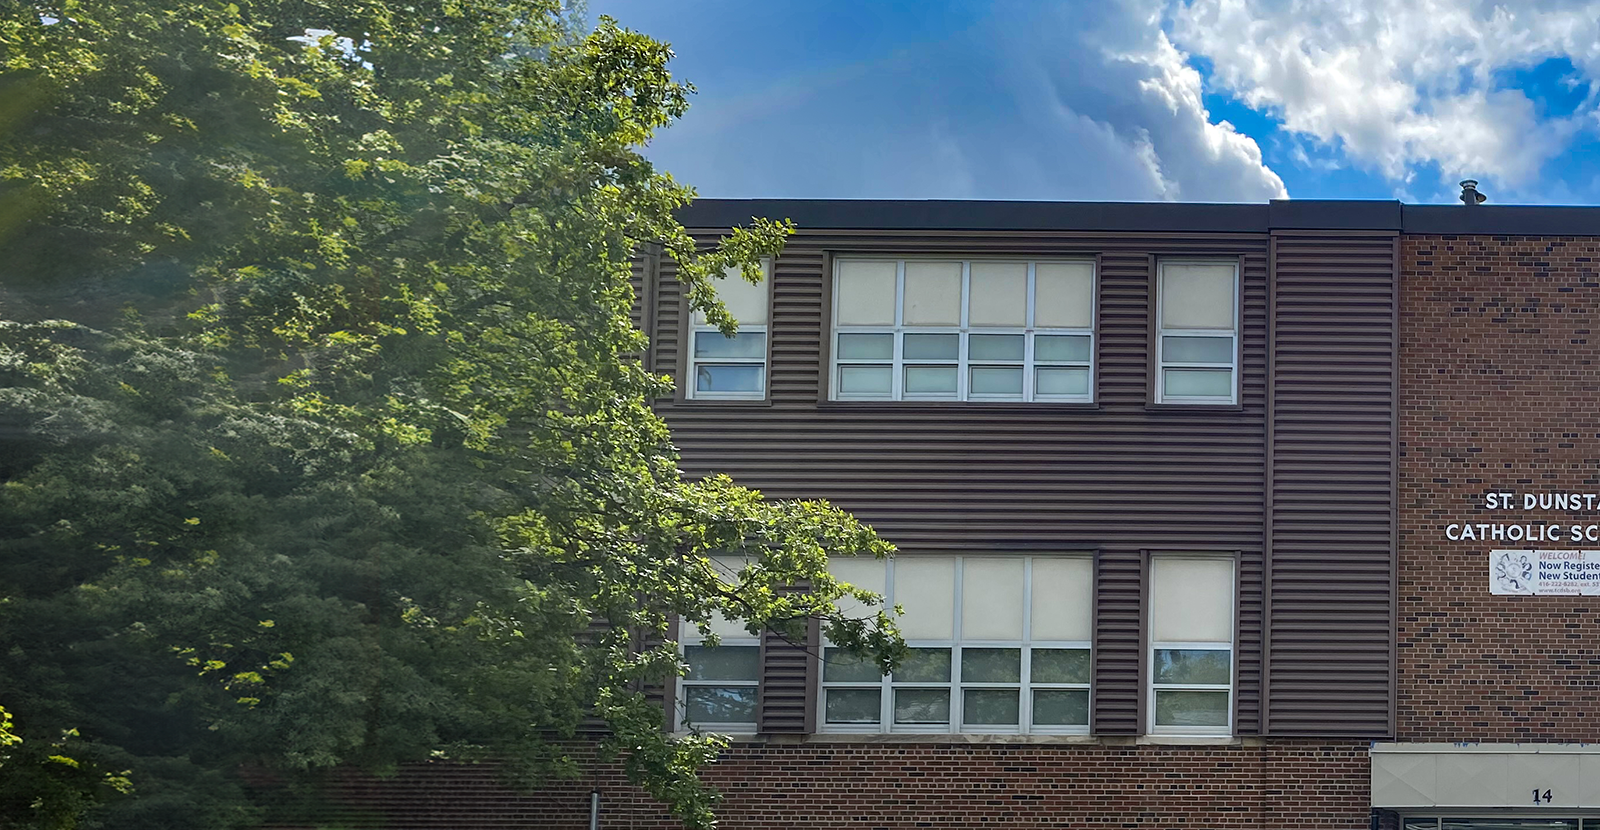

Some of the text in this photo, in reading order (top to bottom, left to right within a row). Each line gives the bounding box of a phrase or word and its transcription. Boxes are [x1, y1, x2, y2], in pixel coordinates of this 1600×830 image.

[1485, 492, 1514, 510] ST.
[1445, 523, 1560, 542] CATHOLIC
[1539, 552, 1586, 560] WELCOME!
[1539, 561, 1562, 570] Now
[1539, 571, 1561, 580] New
[1532, 788, 1553, 804] 14
